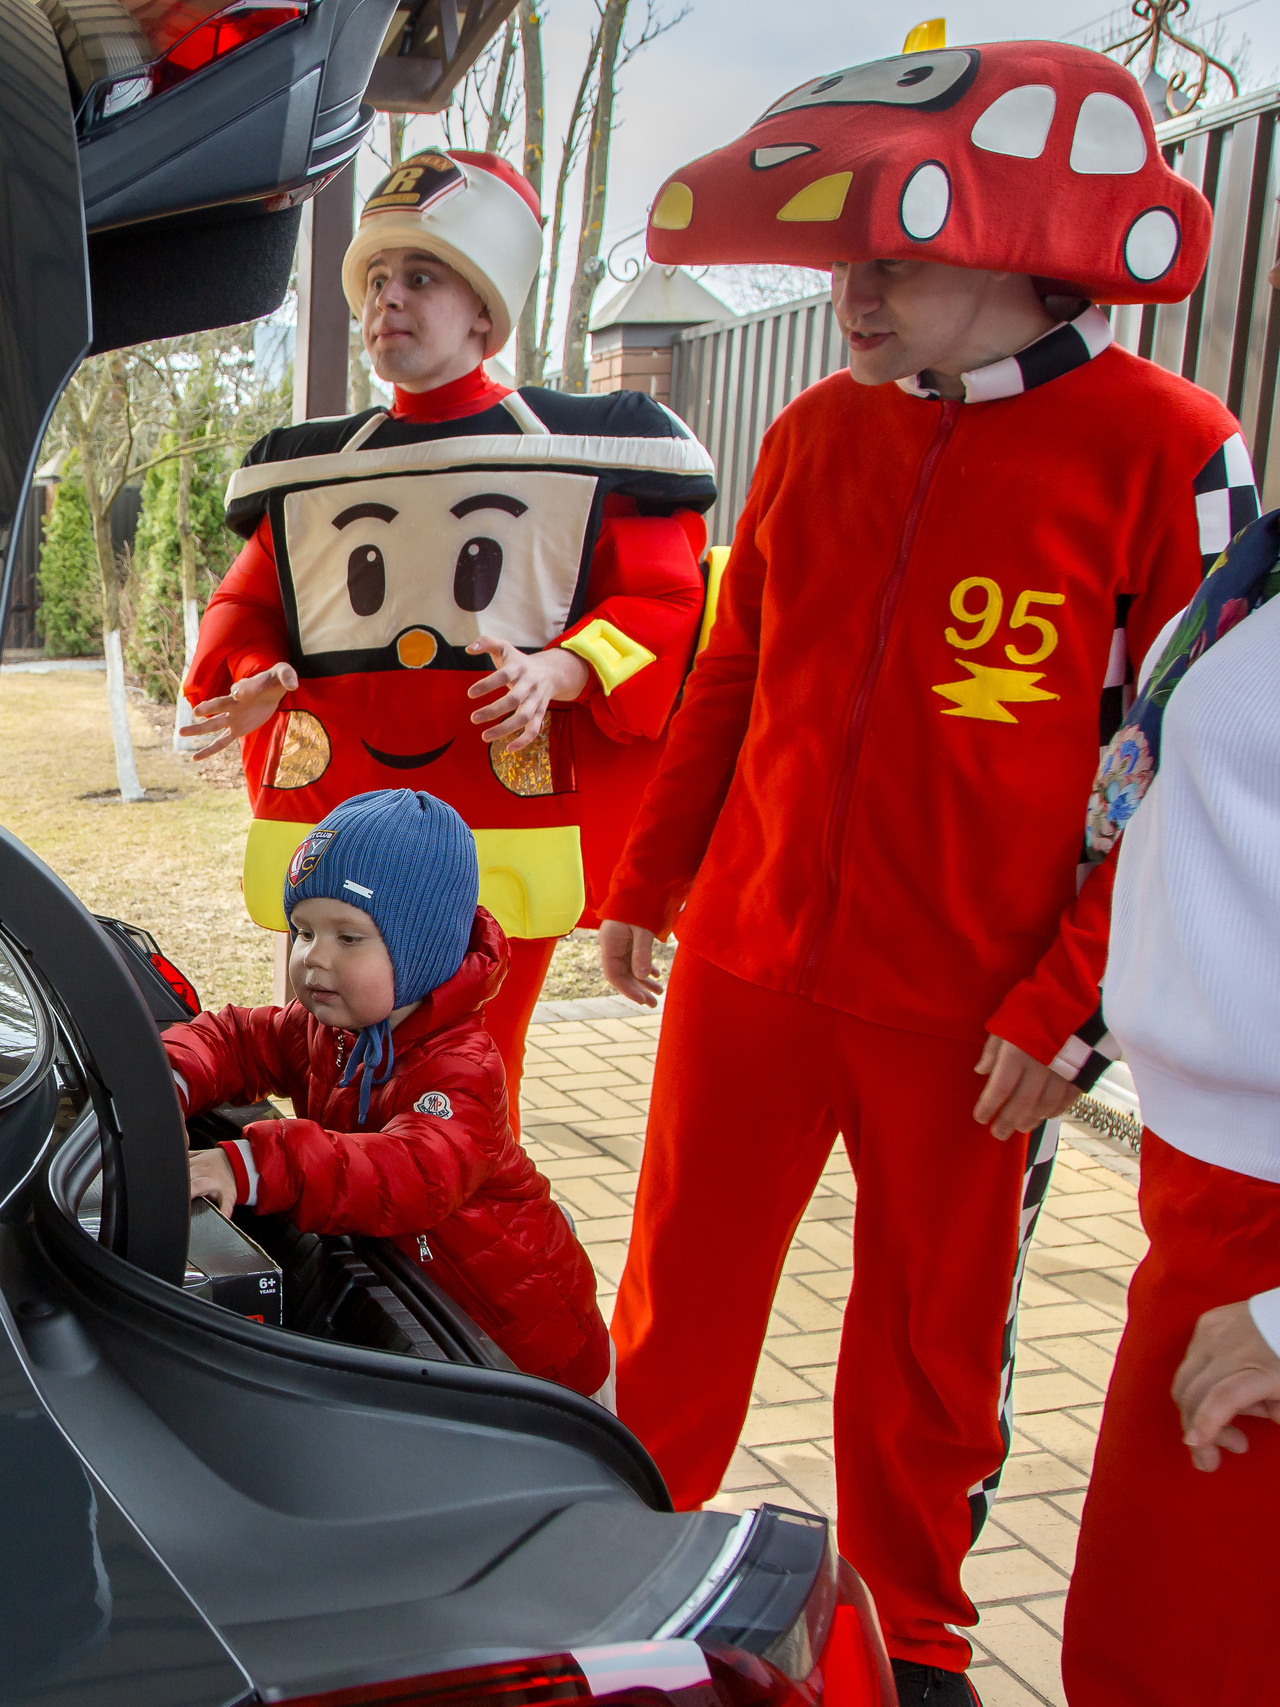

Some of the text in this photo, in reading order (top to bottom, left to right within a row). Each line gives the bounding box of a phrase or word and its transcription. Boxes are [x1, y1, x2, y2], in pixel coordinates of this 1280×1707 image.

[381, 166, 425, 195] R
[944, 576, 1065, 665] 95
[316, 831, 333, 839] CLUB
[311, 840, 325, 855] Y
[301, 856, 316, 871] C
[259, 1277, 276, 1289] 6+
